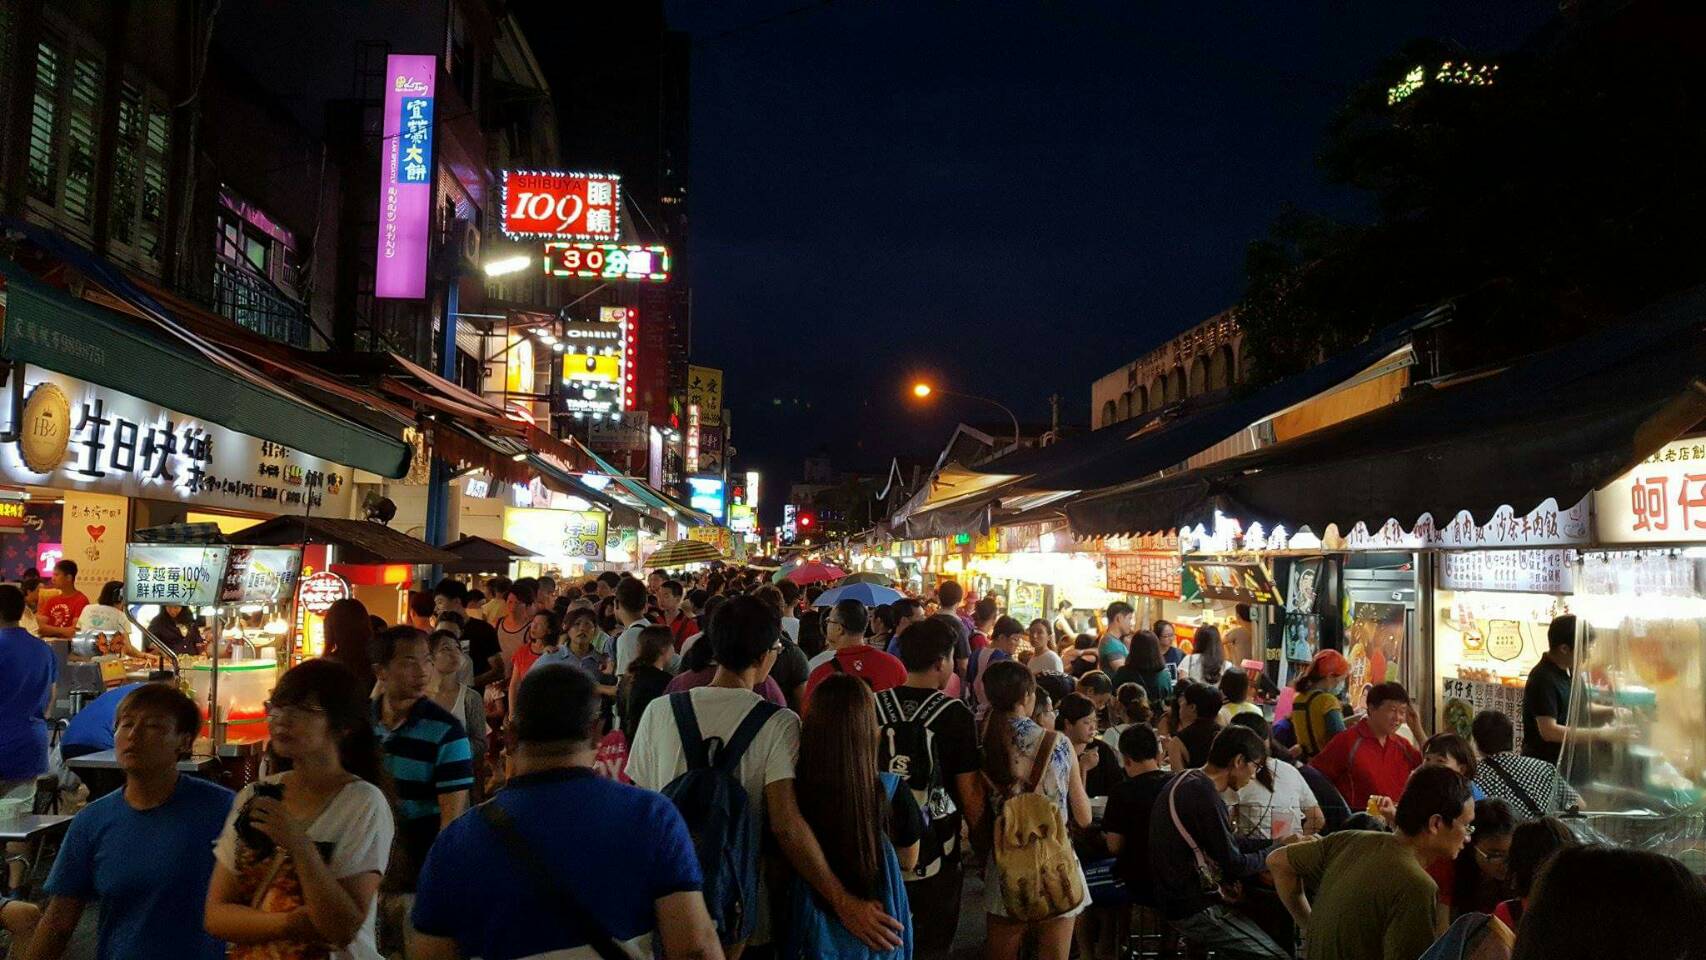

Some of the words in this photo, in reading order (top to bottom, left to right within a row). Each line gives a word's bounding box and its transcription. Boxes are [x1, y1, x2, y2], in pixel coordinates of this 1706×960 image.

[403, 99, 428, 181] 宜蘭大餅
[518, 177, 582, 191] SHIBUYA
[511, 192, 583, 232] 109
[587, 181, 612, 233] 眼鏡
[75, 399, 213, 492] 生日快樂
[136, 583, 197, 599] 鮮榨果汁
[137, 566, 210, 583] 蔓越莓100%
